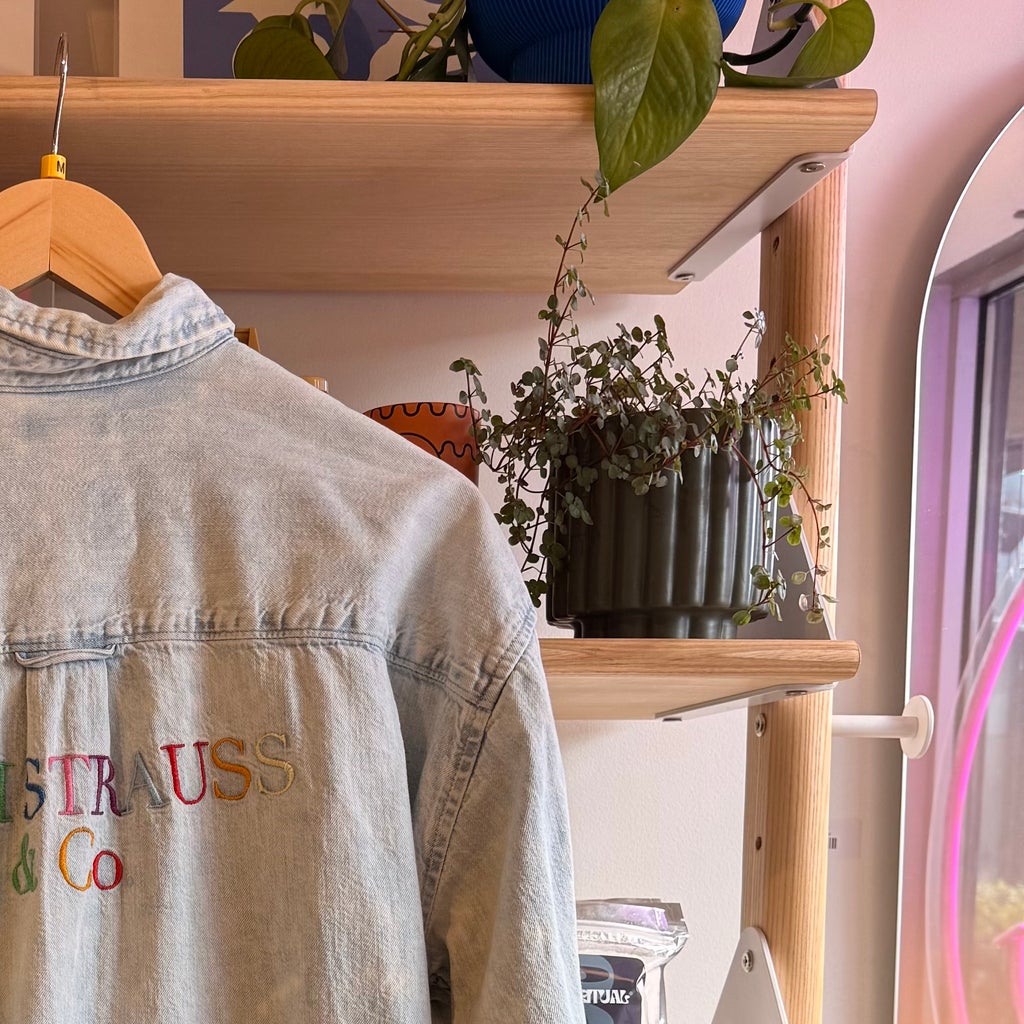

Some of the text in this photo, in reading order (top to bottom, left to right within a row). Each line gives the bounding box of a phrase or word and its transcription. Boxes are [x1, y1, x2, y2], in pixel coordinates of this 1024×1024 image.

[56, 160, 65, 174] M
[23, 731, 297, 821] STRAUSS
[12, 826, 124, 895] & Co
